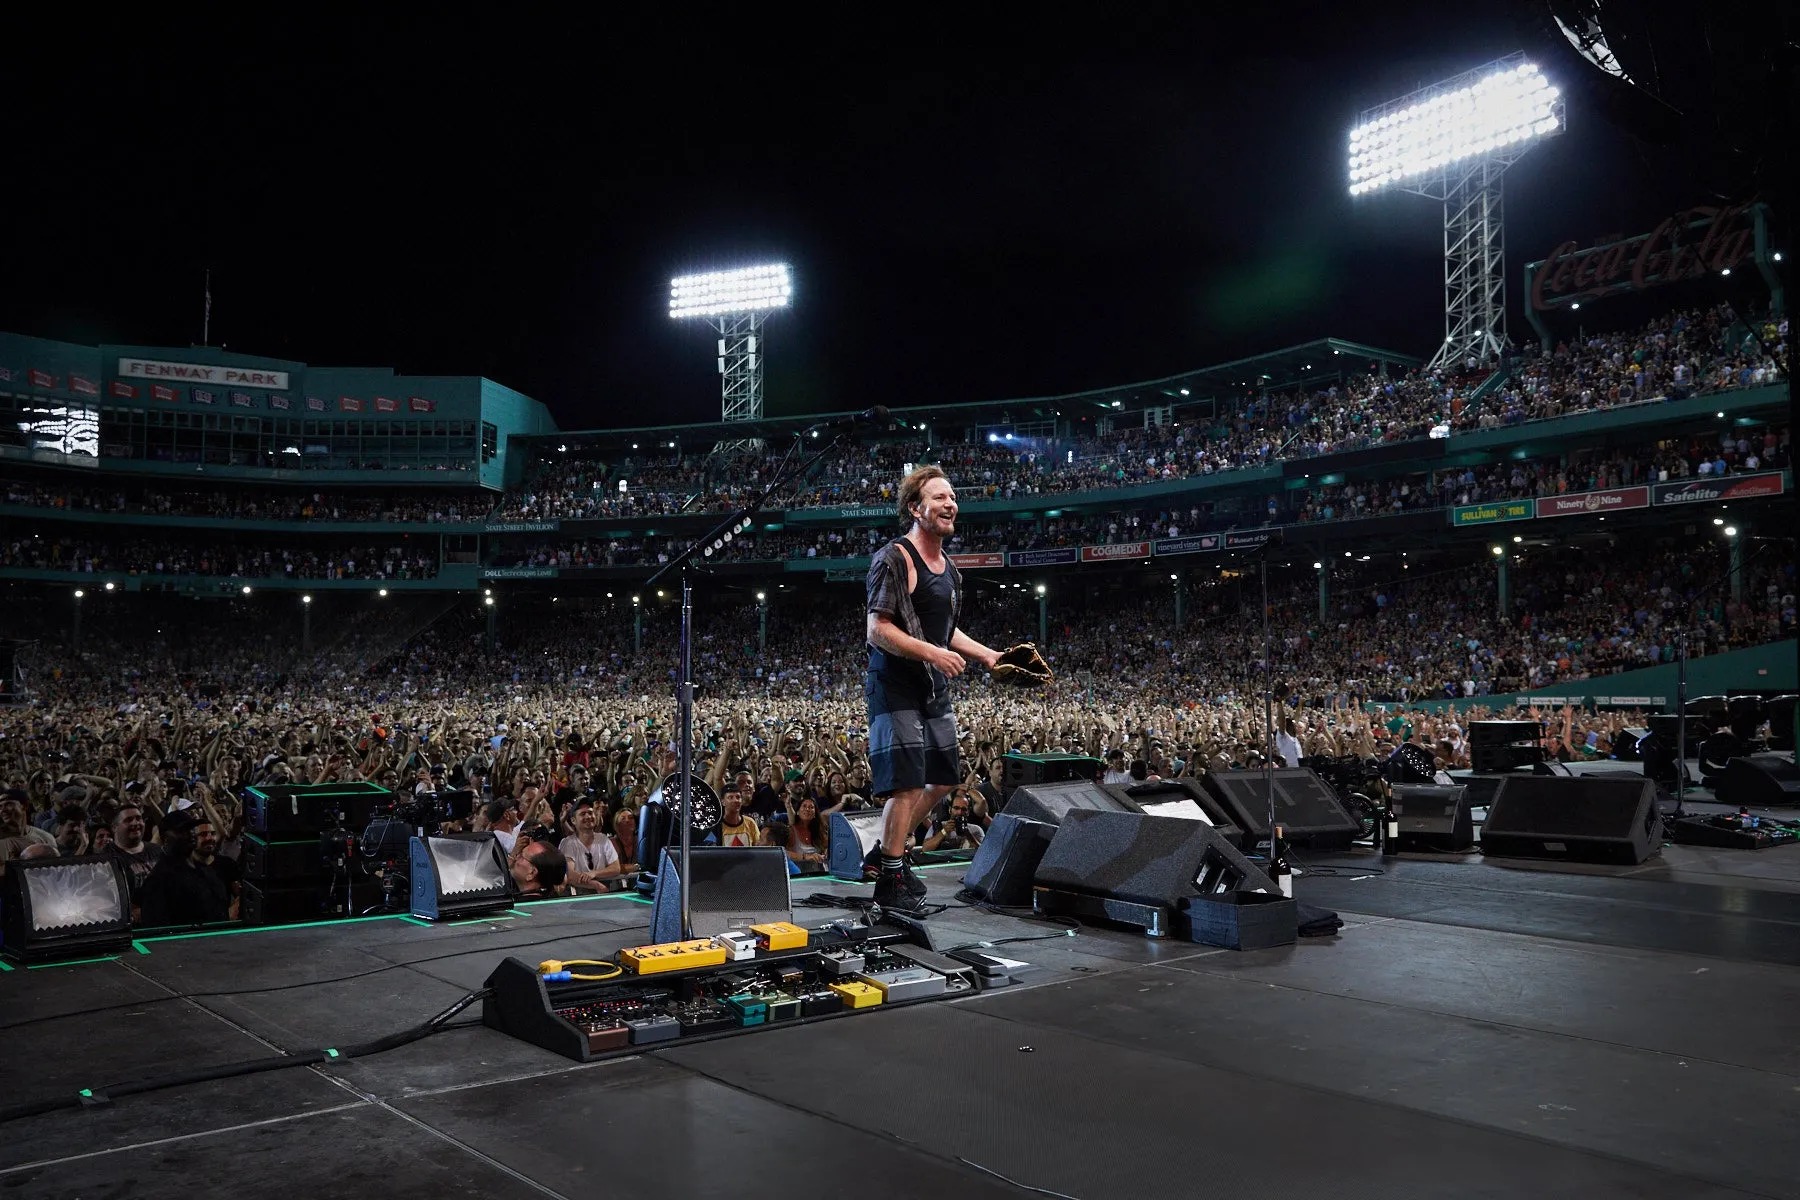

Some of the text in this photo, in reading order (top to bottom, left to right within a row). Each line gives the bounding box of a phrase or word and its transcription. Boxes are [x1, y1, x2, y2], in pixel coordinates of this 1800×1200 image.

[130, 362, 278, 386] FENWAY PARK
[1556, 498, 1584, 510] Ninety
[1600, 495, 1622, 506] Nine
[1663, 488, 1719, 503] Safelite
[841, 509, 860, 518] STATE
[860, 508, 884, 517] STREET
[1461, 505, 1526, 521] SULLIVAN TIRE
[503, 523, 524, 532] STREET
[1090, 543, 1142, 558] COGMEDIX
[1157, 540, 1183, 552] vineyard
[1184, 539, 1201, 549] vines
[484, 569, 502, 578] DELL
